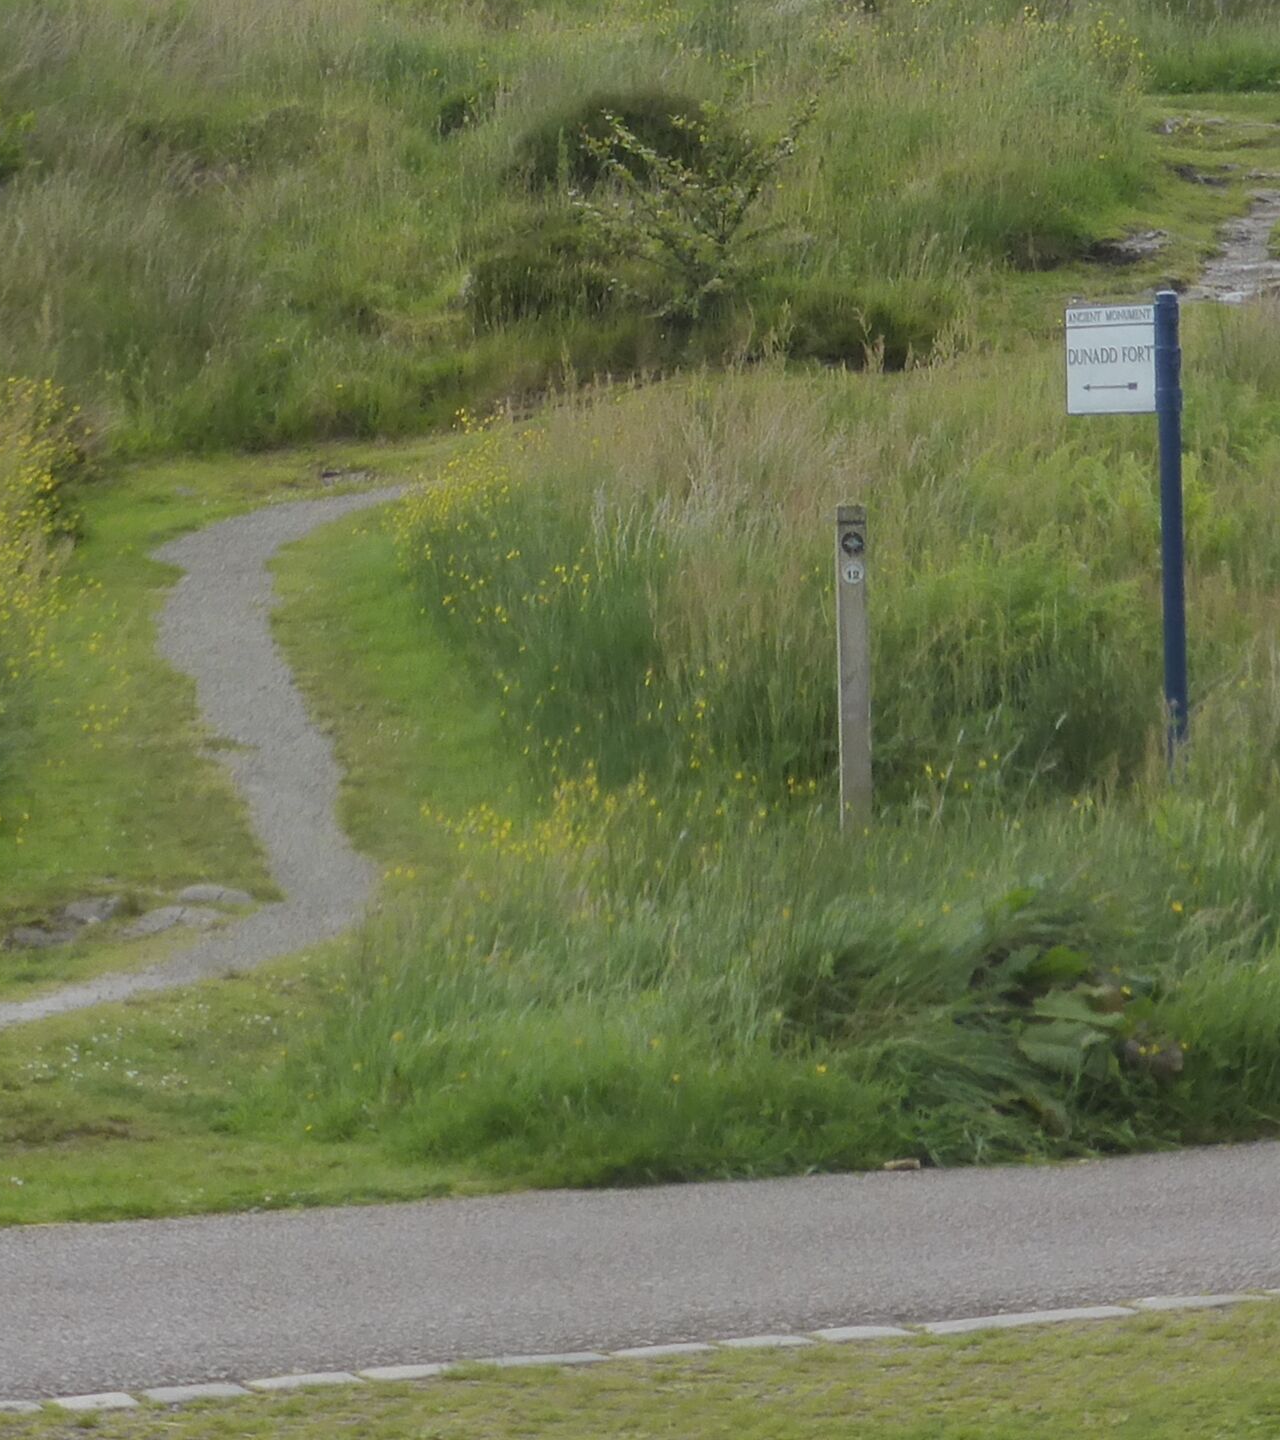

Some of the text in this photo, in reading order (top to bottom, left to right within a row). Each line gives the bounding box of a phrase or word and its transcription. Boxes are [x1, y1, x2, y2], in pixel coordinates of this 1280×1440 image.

[1069, 345, 1154, 365] DUNADD FORT
[847, 570, 860, 580] 12
